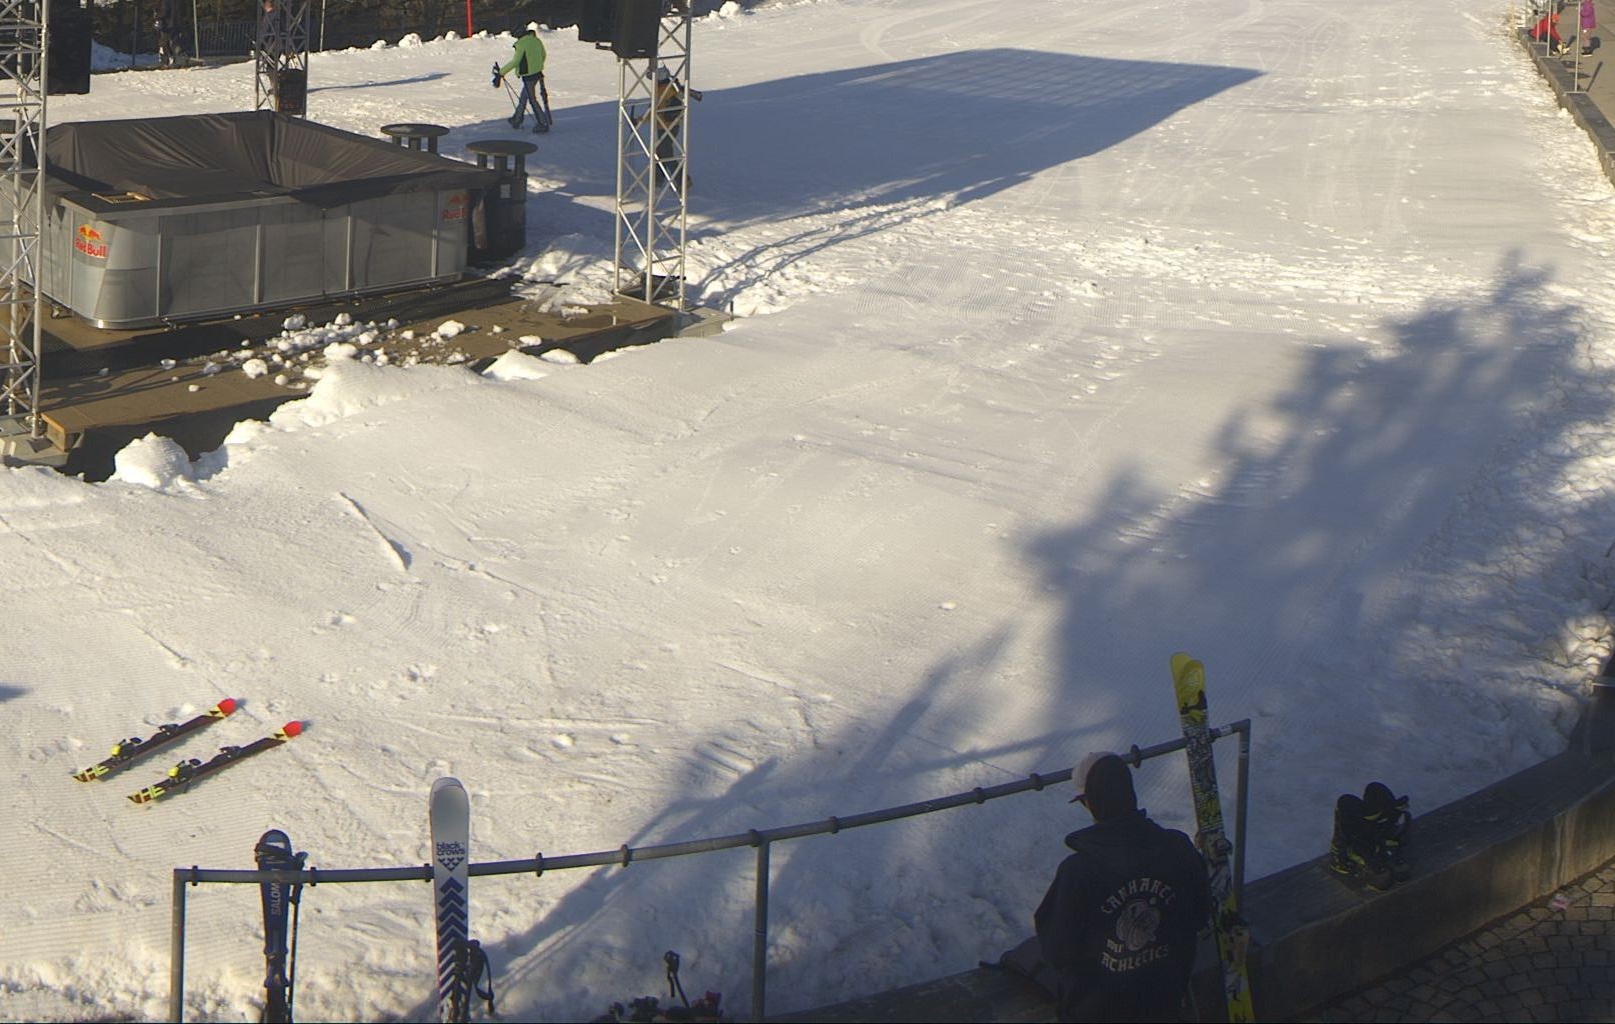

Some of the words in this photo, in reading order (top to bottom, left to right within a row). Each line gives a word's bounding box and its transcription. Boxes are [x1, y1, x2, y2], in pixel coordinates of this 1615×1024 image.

[75, 236, 87, 253] Red
[87, 242, 106, 257] Bull
[437, 841, 461, 850] black
[437, 848, 465, 856] crows
[270, 868, 282, 916] SALOM
[1099, 943, 1170, 973] ATHLETICS
